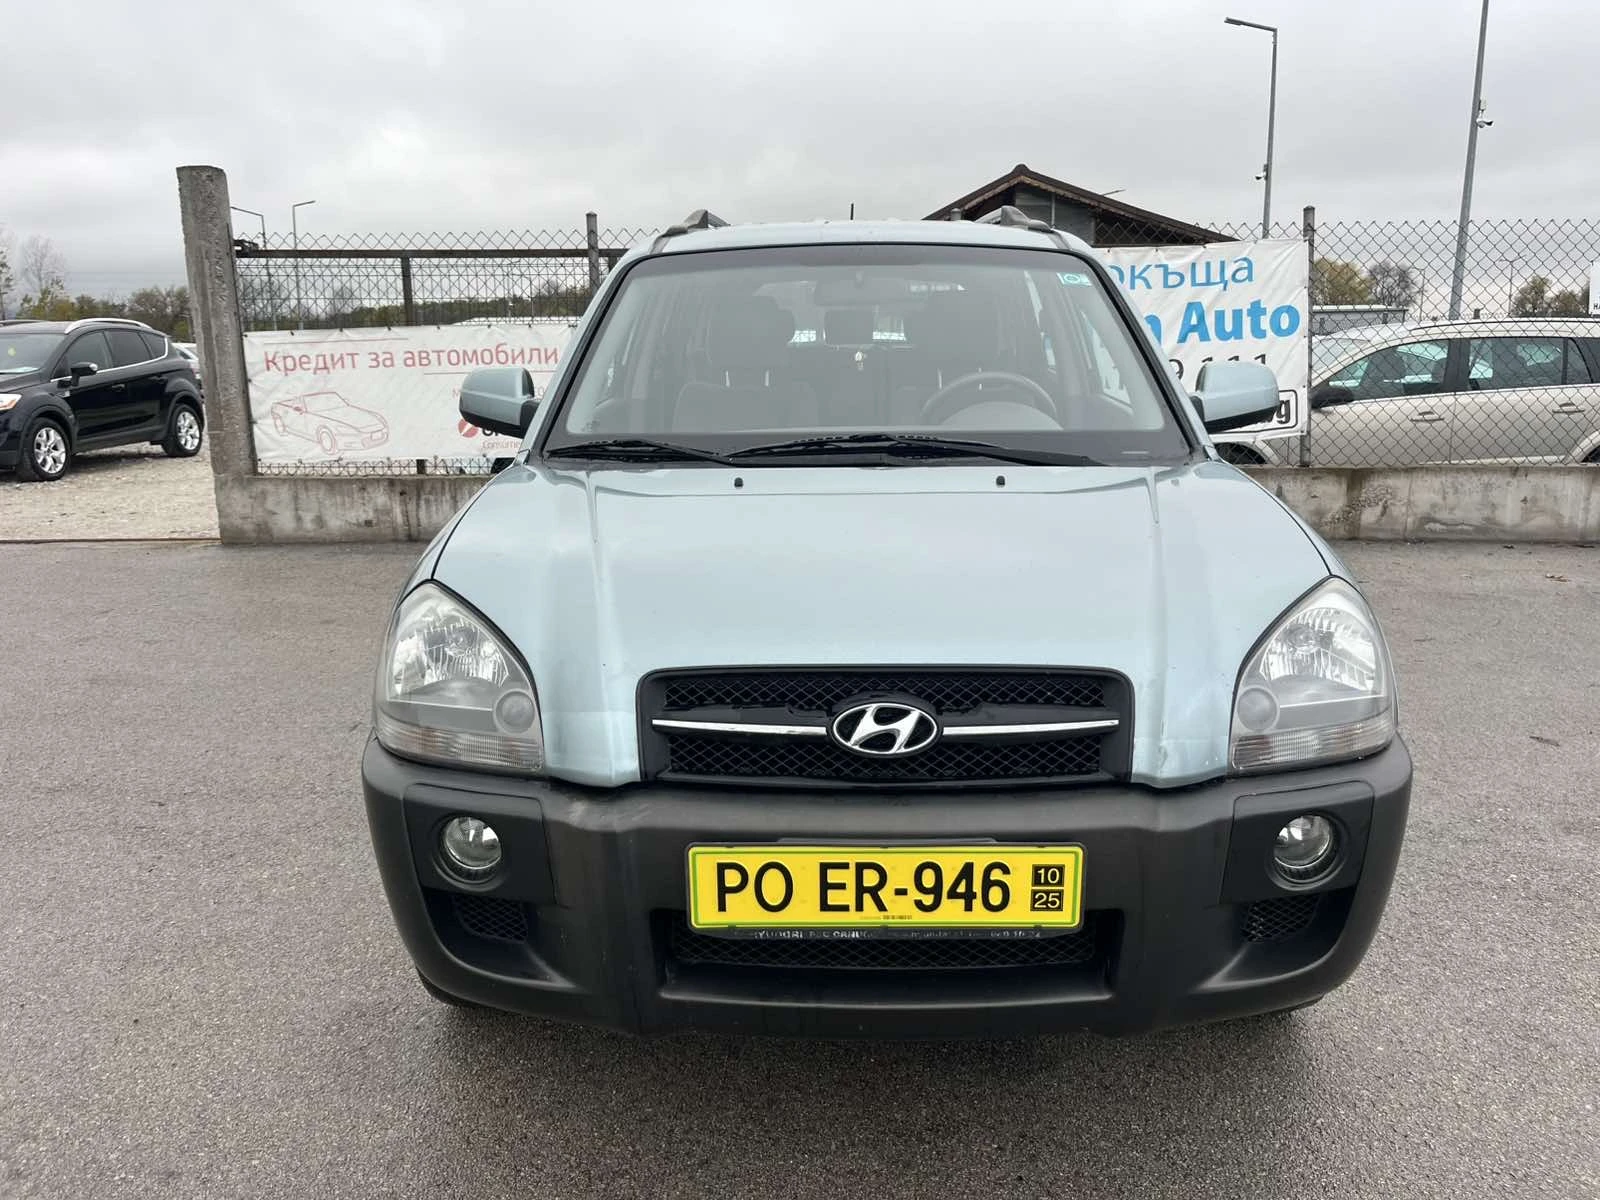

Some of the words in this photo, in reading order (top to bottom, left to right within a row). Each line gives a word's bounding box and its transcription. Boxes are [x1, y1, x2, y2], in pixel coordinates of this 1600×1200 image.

[1177, 299, 1302, 344] Auto
[264, 350, 359, 376] Кредит
[368, 352, 395, 369] за
[403, 343, 559, 368] автомобили
[716, 861, 794, 913] PO
[819, 861, 1011, 913] ER-946
[1037, 868, 1060, 884] 10
[1034, 892, 1060, 909] 25
